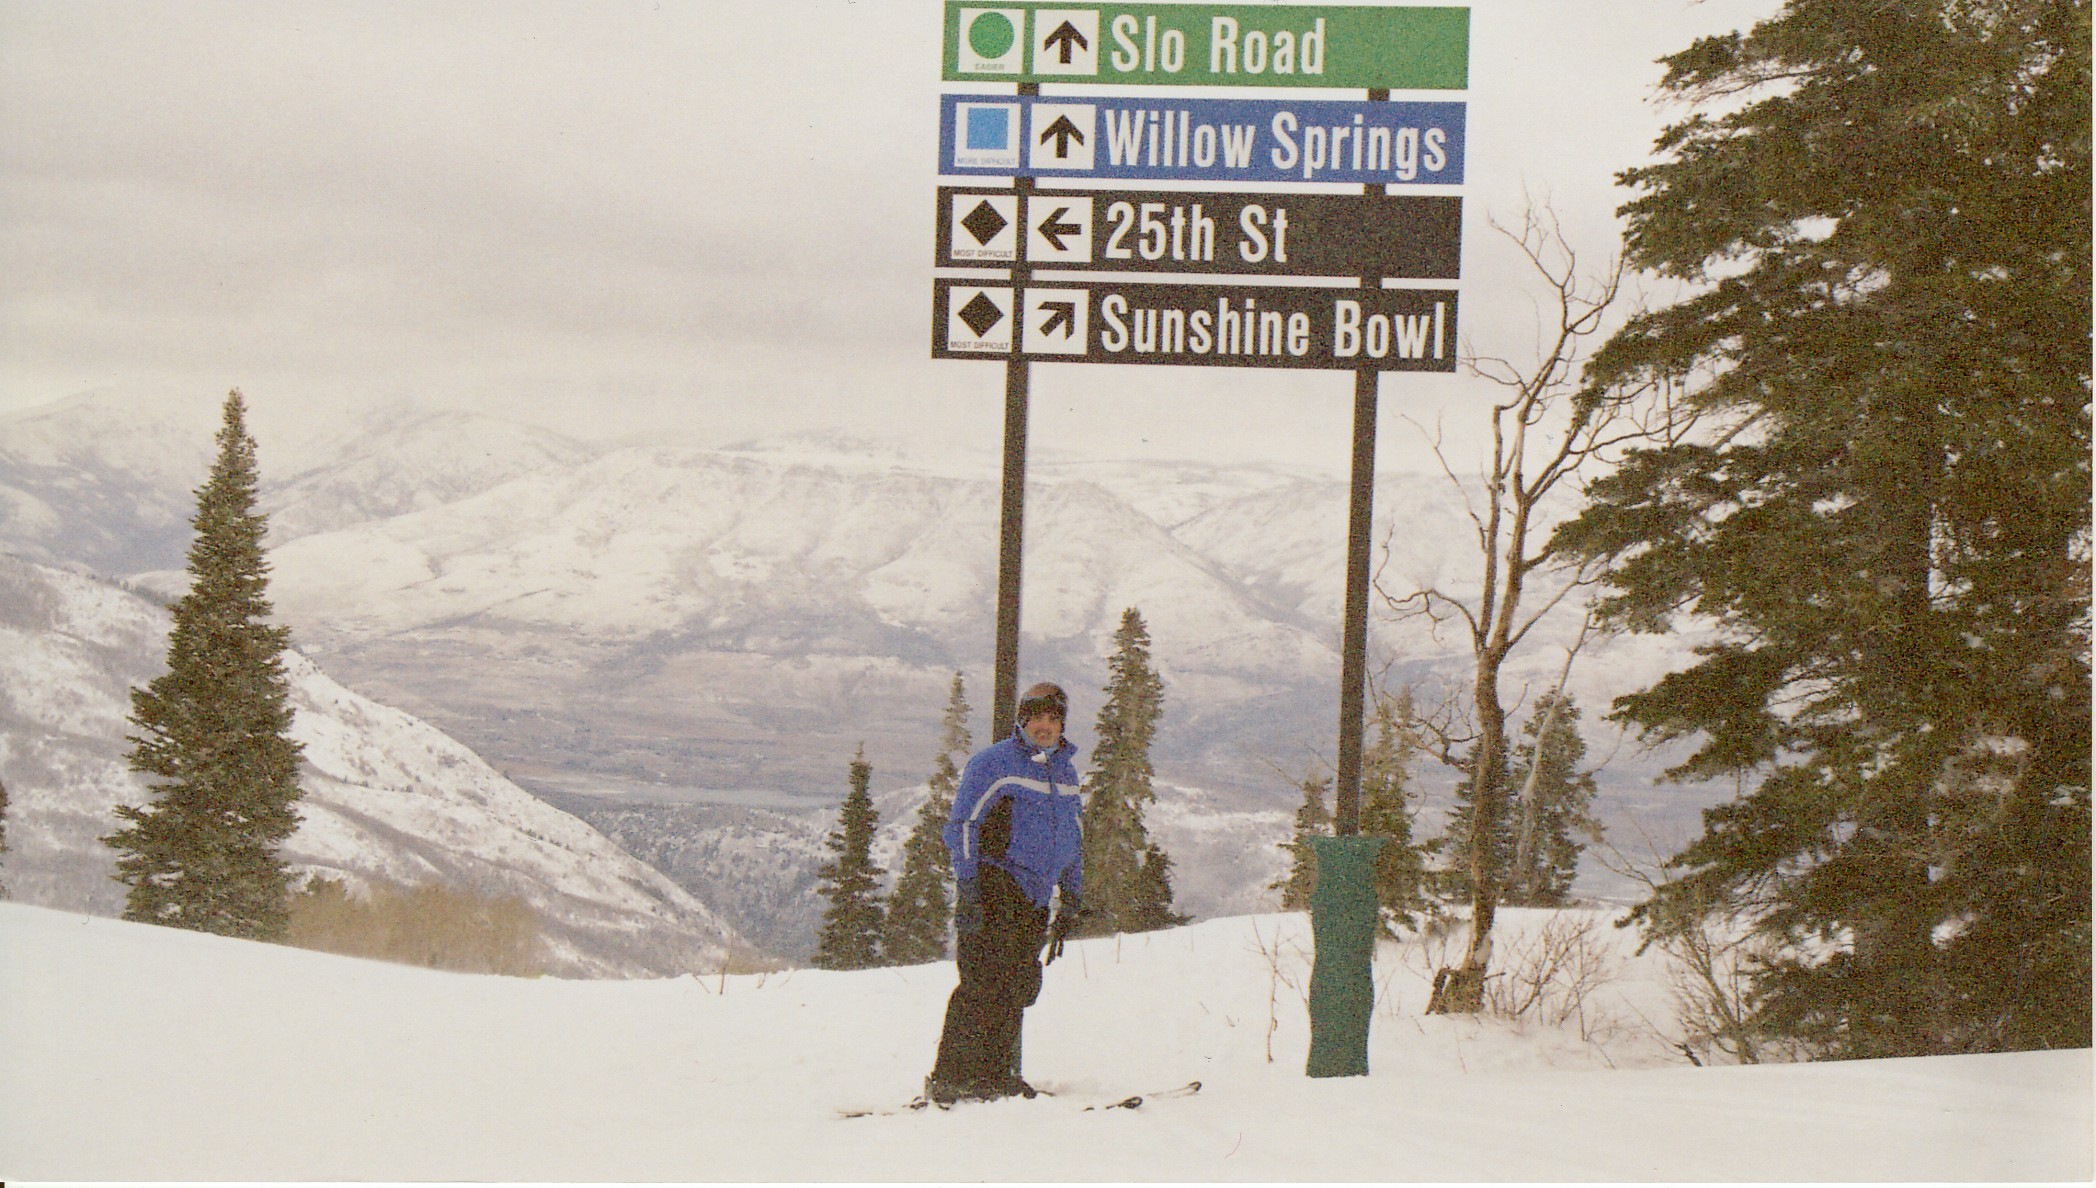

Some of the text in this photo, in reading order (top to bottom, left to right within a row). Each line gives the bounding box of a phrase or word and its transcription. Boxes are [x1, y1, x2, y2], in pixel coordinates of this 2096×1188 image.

[1110, 14, 1325, 75] Slo Road
[1105, 109, 1446, 181] Willow Springs
[953, 249, 976, 257] MOST
[1105, 202, 1288, 263] 25th St
[950, 340, 972, 349] MOST
[1101, 294, 1444, 360] Sunshine Bowl
